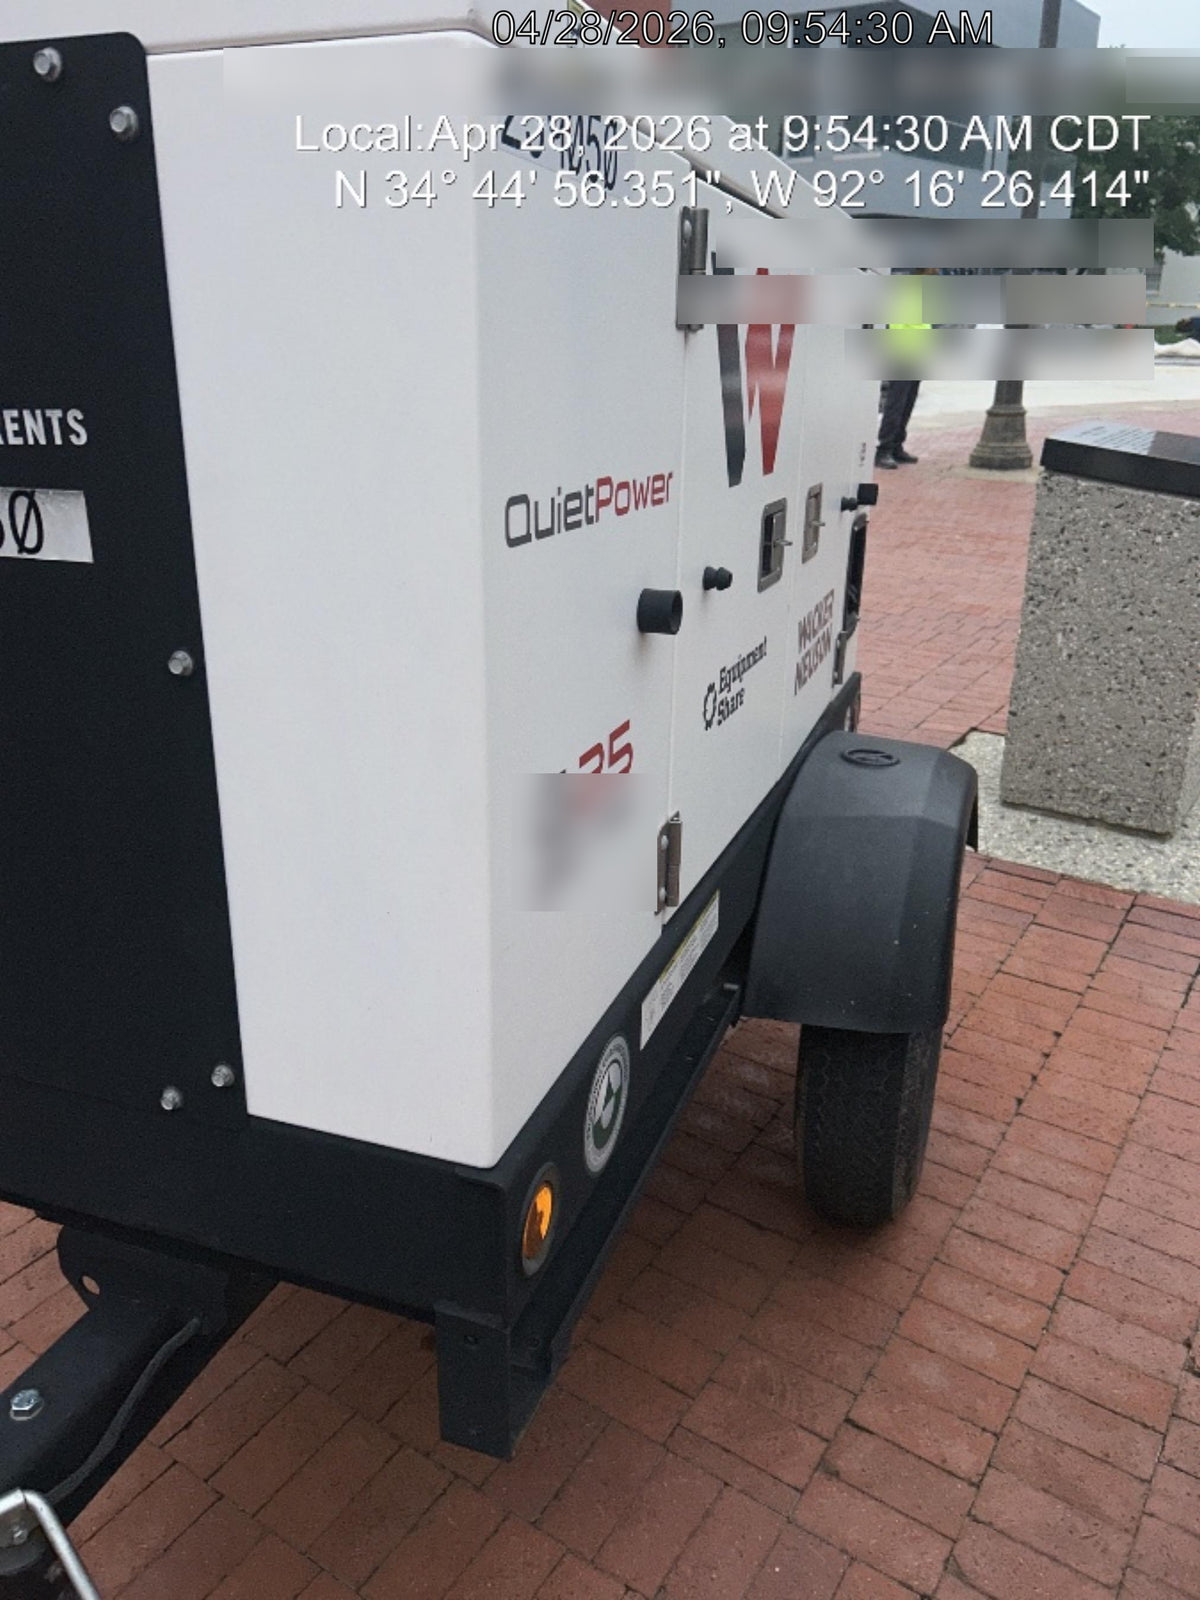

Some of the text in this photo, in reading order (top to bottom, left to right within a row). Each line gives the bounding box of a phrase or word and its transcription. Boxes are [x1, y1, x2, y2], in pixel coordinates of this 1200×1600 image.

[0, 408, 88, 446] ENTS
[505, 471, 673, 549] QuietPower
[718, 635, 767, 695] Equipment
[717, 687, 745, 726] Share
